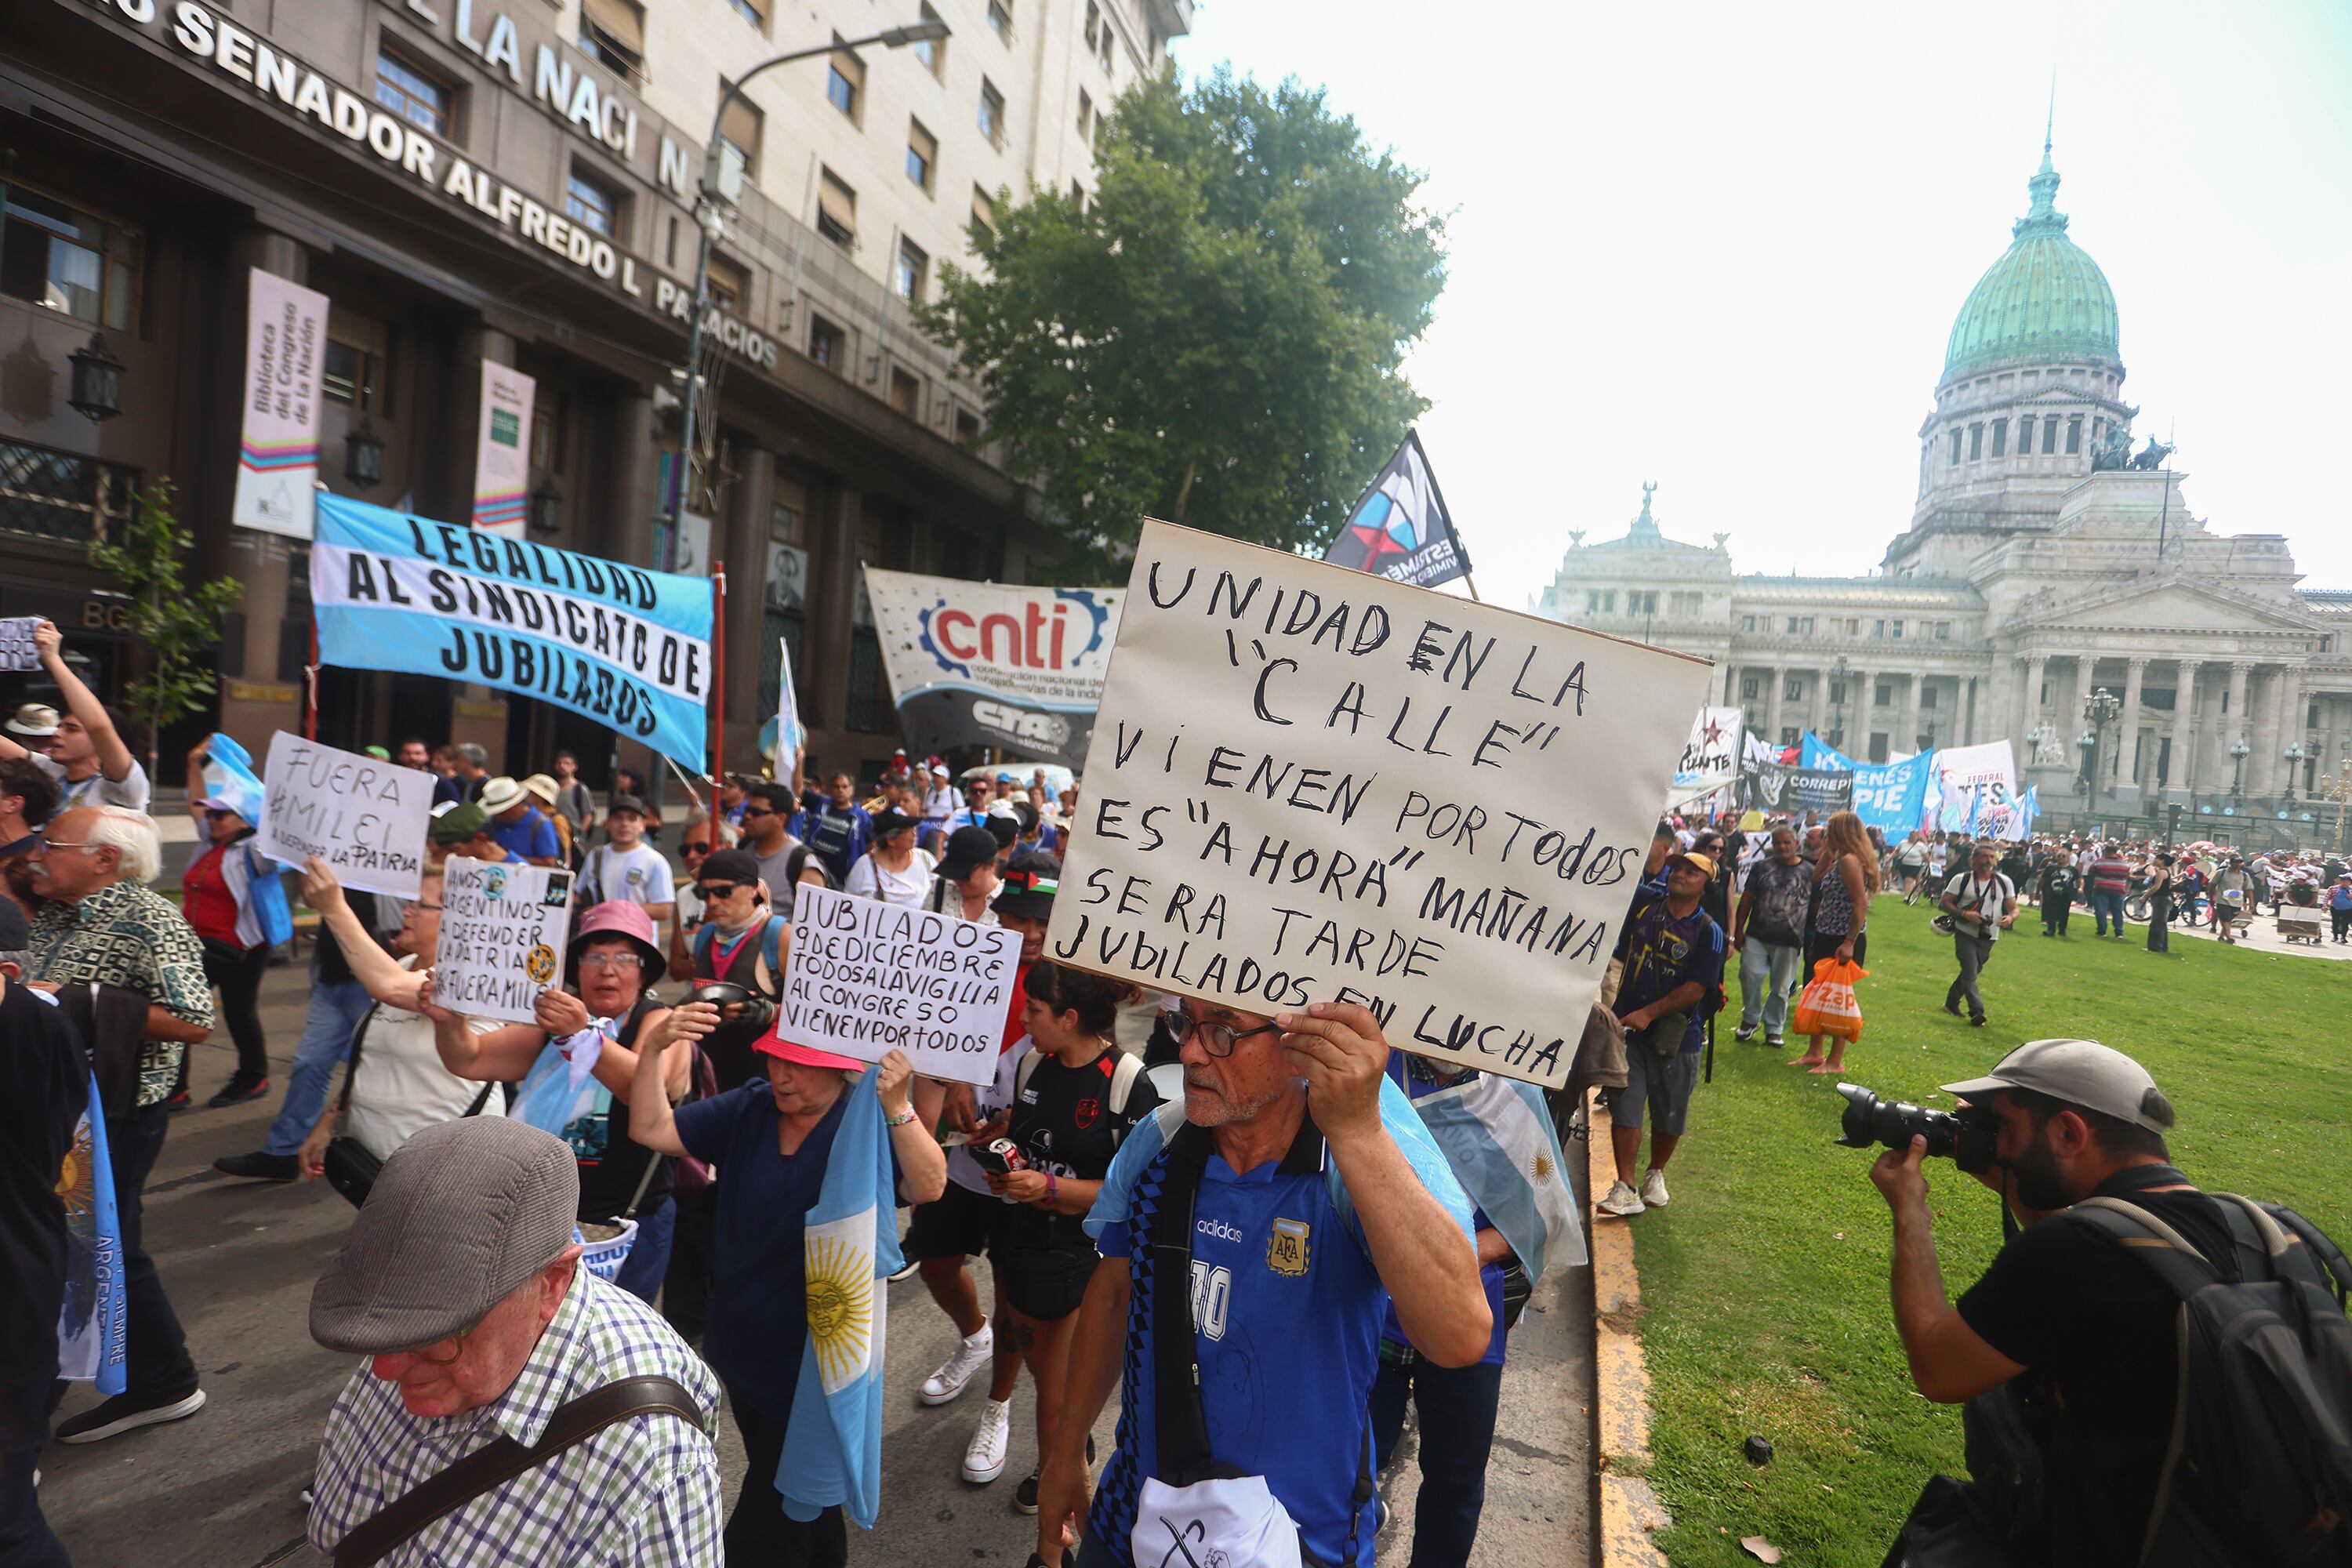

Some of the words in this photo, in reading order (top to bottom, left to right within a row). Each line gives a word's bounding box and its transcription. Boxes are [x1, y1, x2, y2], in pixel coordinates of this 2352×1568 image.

[455, 0, 523, 85] LA
[172, 1, 436, 183] SENADOR
[444, 157, 616, 279] ALFREDO
[622, 247, 642, 298] L
[657, 275, 778, 370] PAACIOS
[255, 322, 276, 415] Biblioteca
[276, 301, 298, 387] Congreso
[297, 316, 316, 379] Nación
[274, 390, 291, 420] del
[294, 403, 310, 426] de
[296, 382, 311, 399] la
[408, 519, 657, 610] LEGALIDAD
[348, 553, 410, 604] AL
[430, 568, 648, 672] SINDICATO
[659, 635, 700, 696] DE
[937, 601, 1068, 670] cnti
[1148, 560, 1391, 656] UNIDAD
[1407, 619, 1497, 691] EN
[1512, 644, 1591, 717] LA
[441, 628, 657, 736] JUBILADOS
[1039, 673, 1086, 687] nacional
[286, 748, 401, 807] FUERA
[1396, 790, 1489, 855] POR
[1095, 797, 1171, 852] ES
[1417, 876, 1607, 965] MAÑANA
[452, 921, 543, 947] DEFENDER
[798, 890, 1004, 955] JUBILADOS
[1080, 867, 1229, 941] SERA
[1271, 906, 1446, 978] TARDE
[789, 977, 811, 1003] AL
[818, 984, 958, 1025] CONGRESO
[1334, 987, 1398, 1033] EN
[1414, 1004, 1566, 1077] LUCHA
[1817, 985, 1857, 1011] Zap
[1196, 1218, 1243, 1244] adidas
[1190, 1258, 1232, 1342] 10
